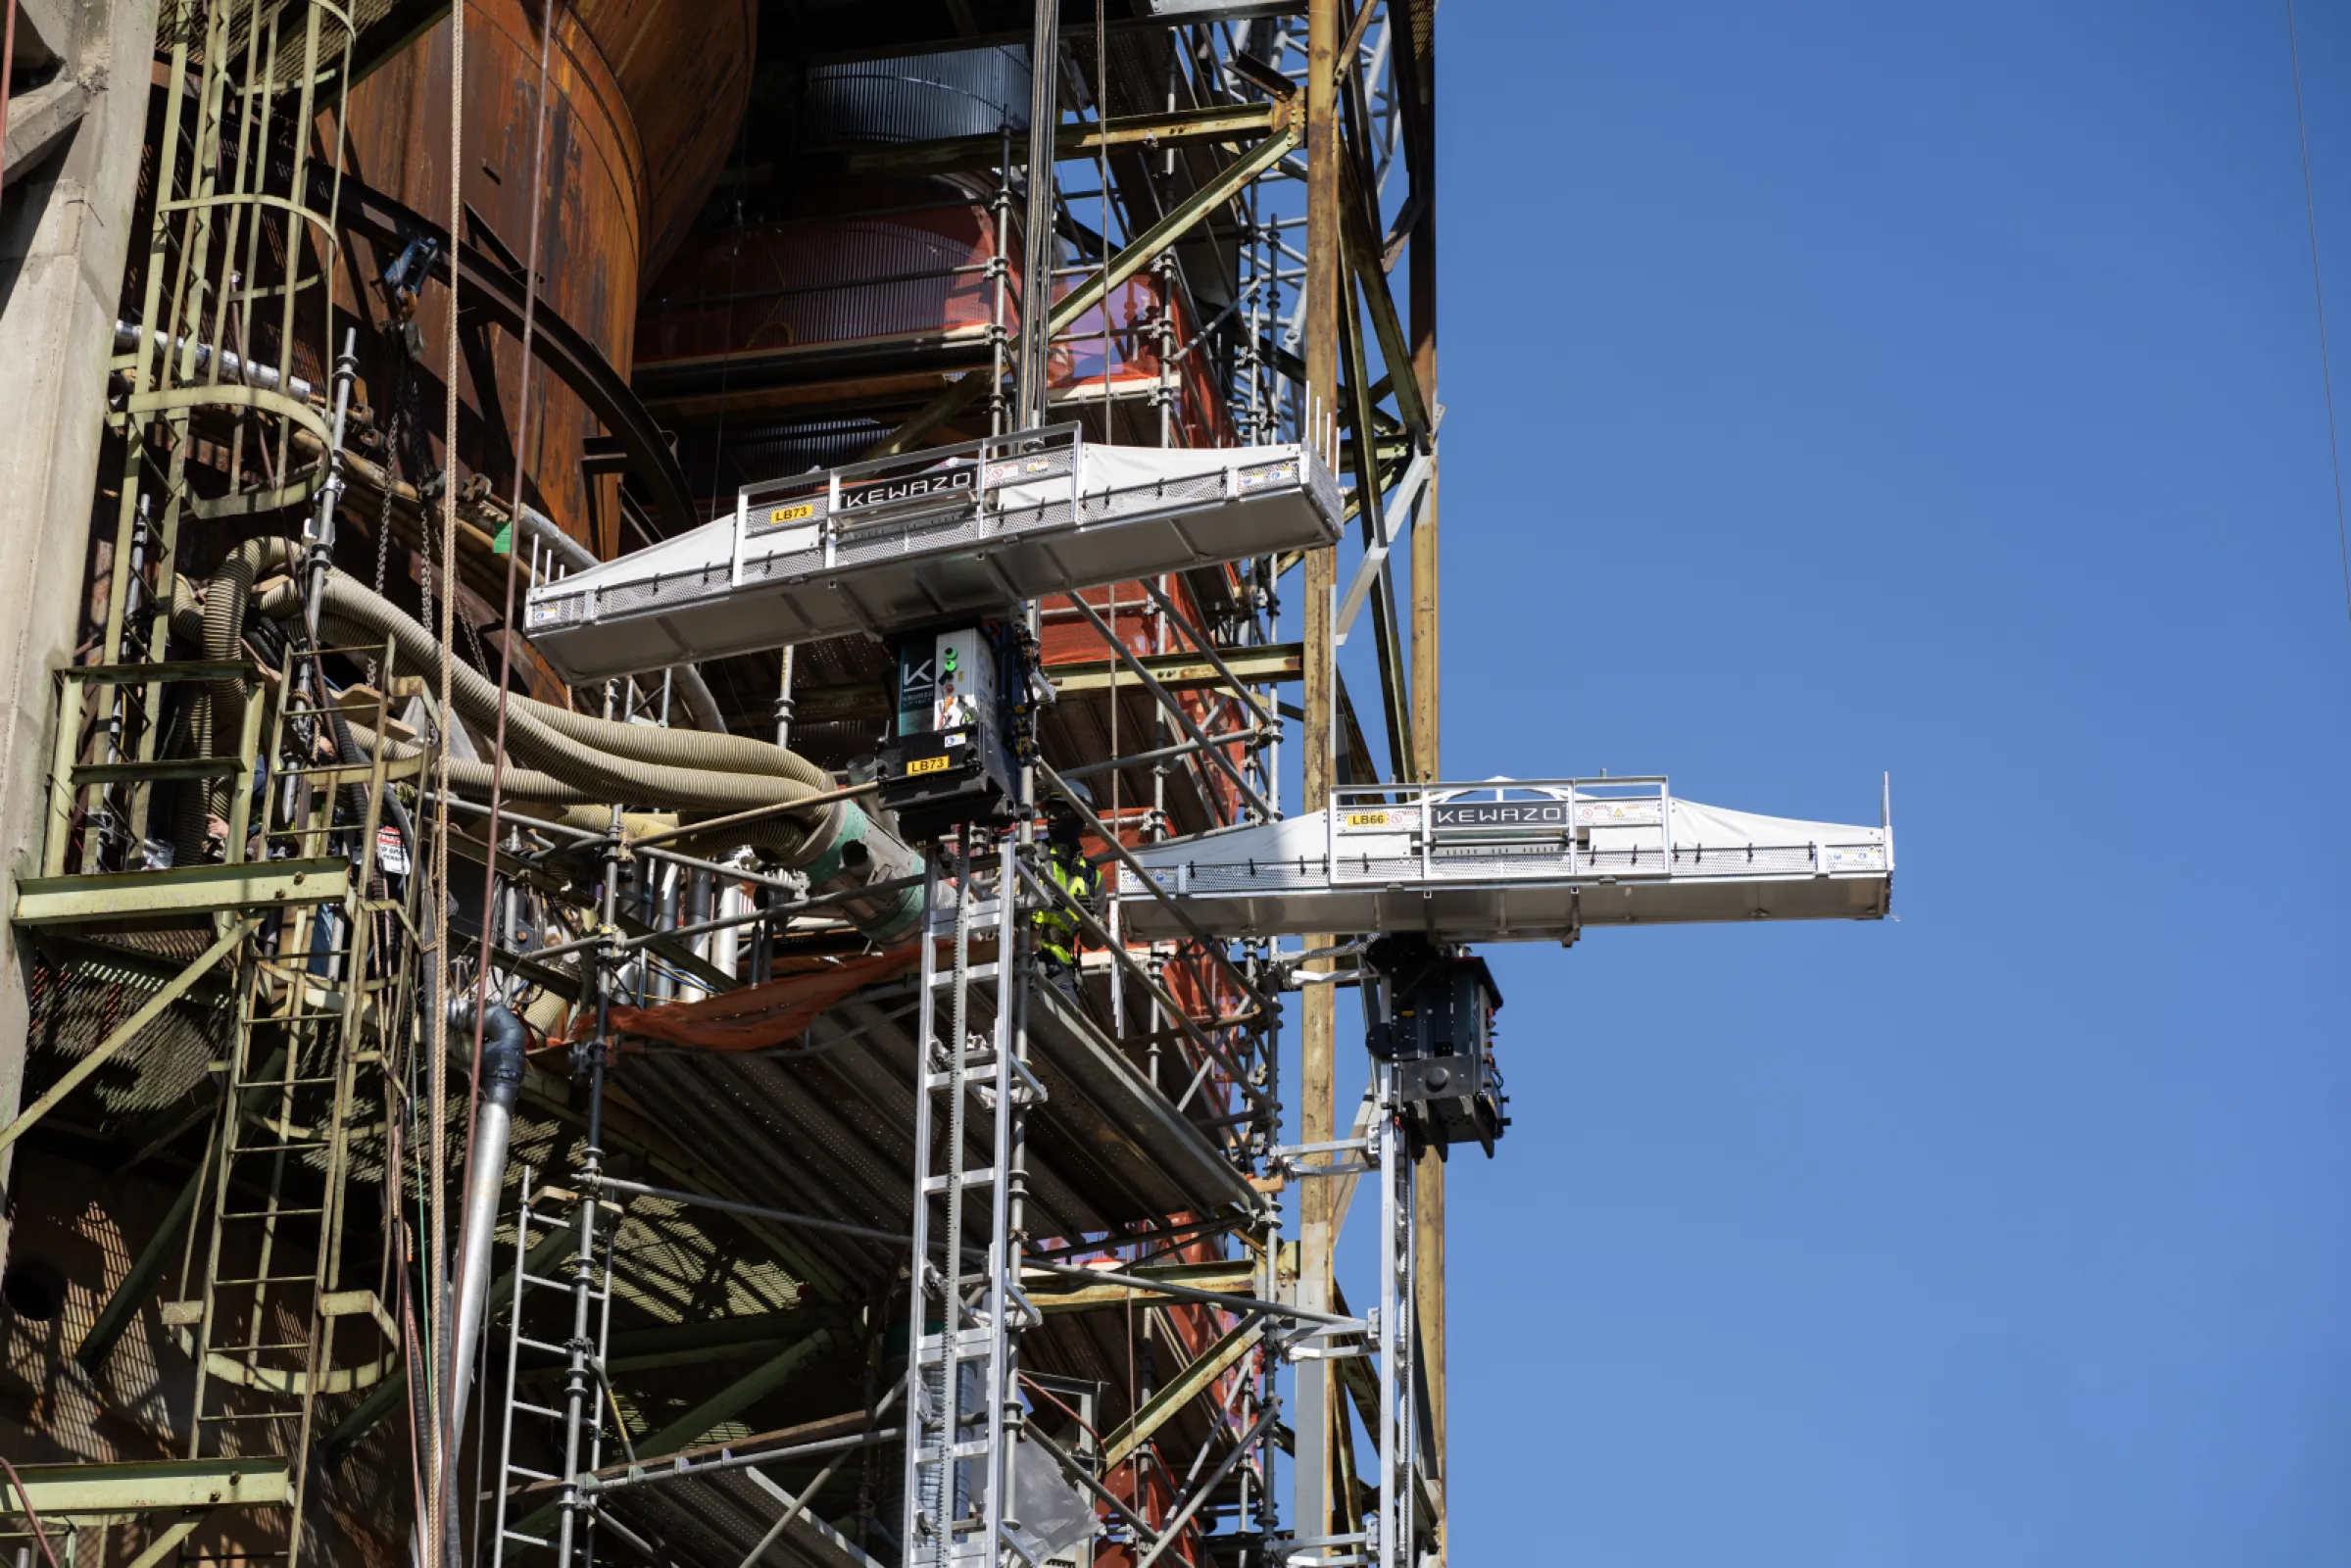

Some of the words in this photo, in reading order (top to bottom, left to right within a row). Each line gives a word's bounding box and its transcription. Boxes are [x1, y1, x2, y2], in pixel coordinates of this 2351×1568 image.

[847, 472, 970, 508] KEWAZO
[775, 507, 808, 521] LB73
[911, 758, 944, 772] LB73
[1352, 814, 1384, 825] LB66
[1438, 808, 1561, 824] KEWAZO
